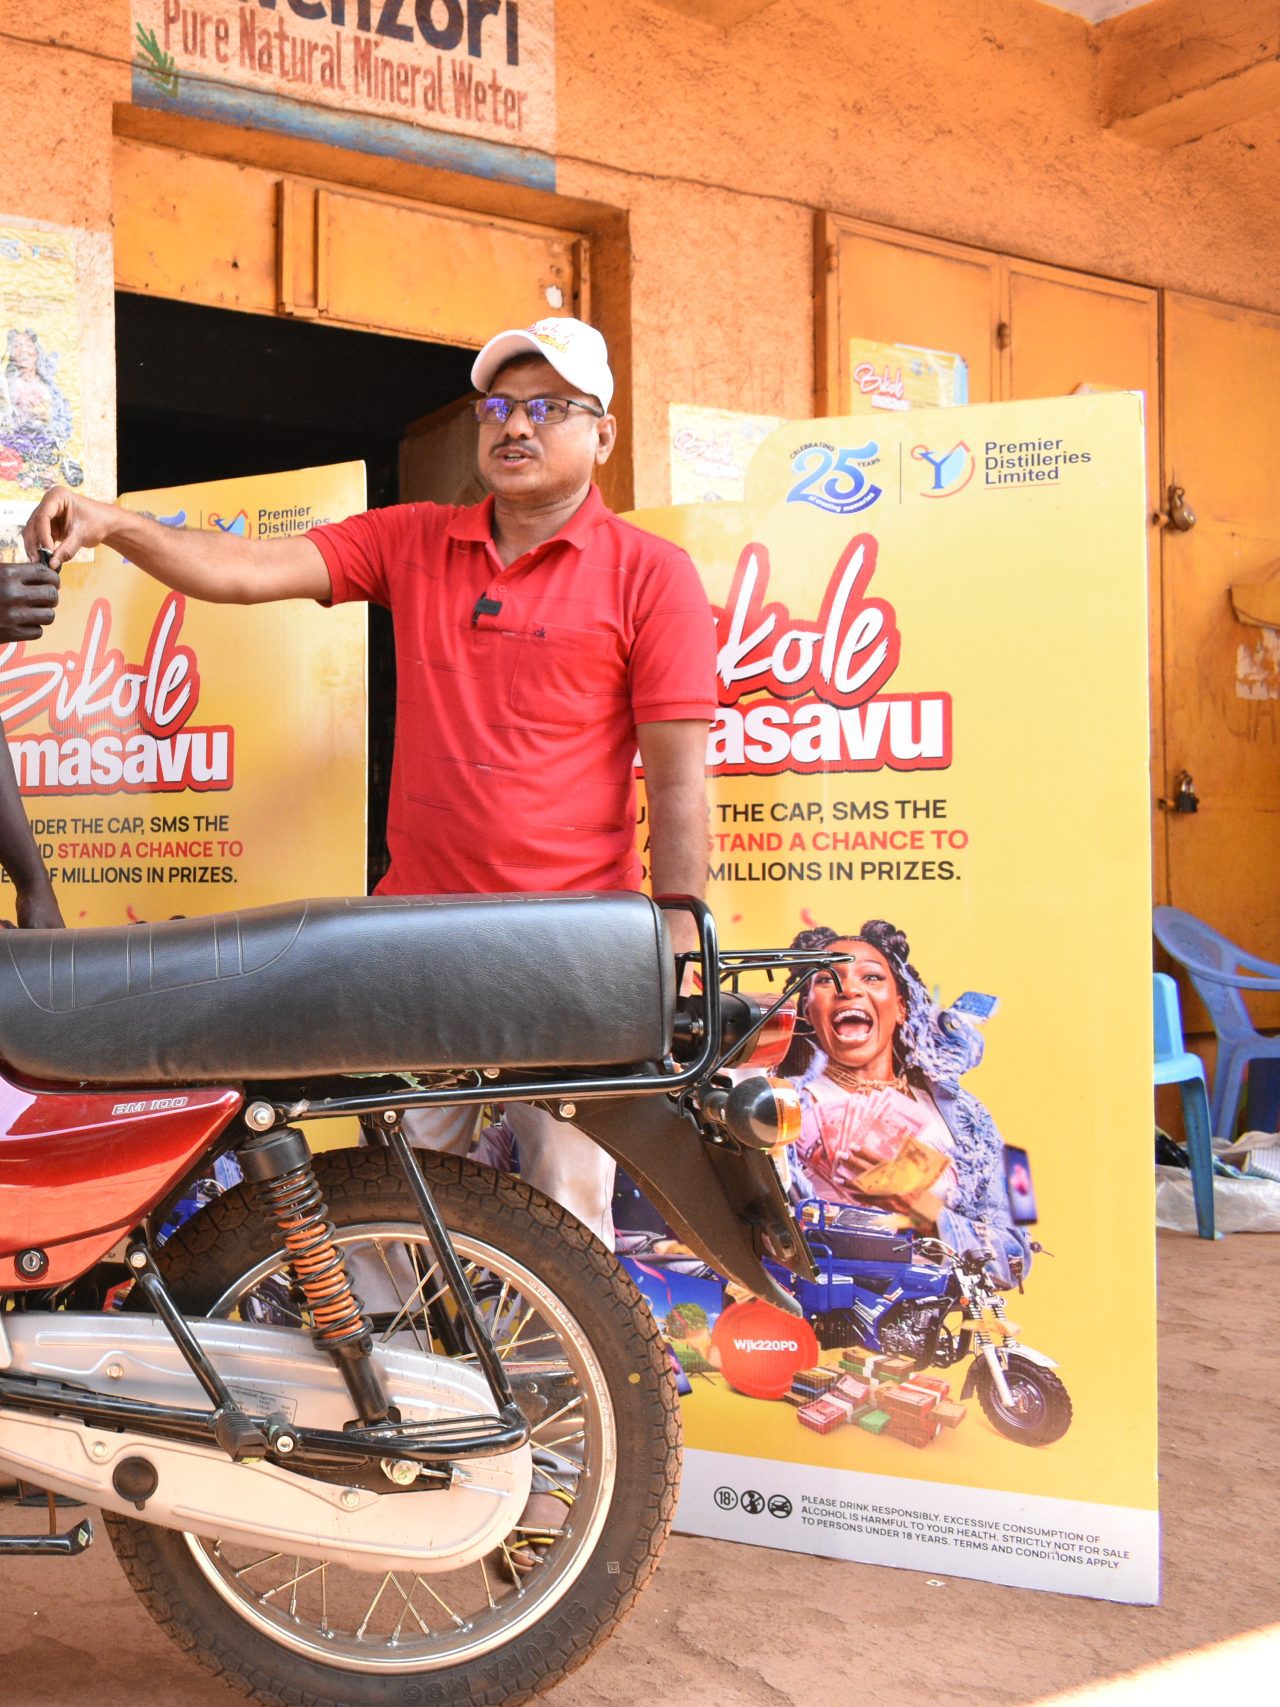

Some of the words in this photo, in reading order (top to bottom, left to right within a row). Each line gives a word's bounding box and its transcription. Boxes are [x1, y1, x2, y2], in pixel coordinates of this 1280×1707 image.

[163, 2, 229, 63] Pure
[239, 8, 345, 92] Natural
[354, 36, 446, 113] Mineral
[789, 441, 836, 460] CELEBRATING
[985, 438, 1063, 455] Premier
[786, 439, 880, 503] 25
[985, 451, 1091, 470] Distilleries
[985, 467, 1059, 485] Limited
[258, 505, 312, 521] Premier
[713, 543, 889, 694] kole
[705, 700, 944, 766] asavu
[8, 731, 228, 787] masavu
[717, 803, 765, 822] THE
[770, 802, 824, 824] CAP,
[832, 800, 889, 820] SMS
[895, 799, 947, 819] THE
[30, 819, 67, 834] DER
[71, 818, 104, 834] THE
[107, 817, 145, 836] CAP,
[150, 816, 190, 832] SMS
[193, 815, 230, 832] THE
[58, 842, 116, 859] STAND
[120, 842, 132, 858] A
[136, 841, 214, 858] CHANCE
[217, 841, 244, 857] TO
[789, 832, 806, 851] A
[812, 830, 925, 851] CHANCE
[930, 829, 969, 849] TO
[62, 867, 143, 883] MILLIONS
[147, 867, 164, 883] IN
[169, 866, 238, 883] PRIZES.
[707, 862, 822, 881] MILLIONS
[829, 862, 853, 880] IN
[861, 860, 961, 880] PRIZES.
[112, 1101, 146, 1115] BM
[150, 1096, 189, 1111] 100
[733, 1339, 798, 1353] Wjk220PD
[801, 1495, 838, 1508] PLEASE
[839, 1500, 869, 1512] DRINK
[871, 1505, 942, 1522] RESPONSIBLY.
[944, 1515, 1000, 1530] EXCESSIVE
[1002, 1523, 1084, 1542] CONSUMPTION
[1086, 1534, 1101, 1544] OF
[801, 1506, 847, 1520] ALCOHOL
[849, 1513, 859, 1521] IS
[861, 1515, 908, 1529] HARMFUL
[911, 1521, 924, 1531] TO
[926, 1524, 954, 1535] YOUR
[1002, 1534, 1052, 1549] STRICTLY
[1054, 1542, 1076, 1553] NOT
[1078, 1545, 1099, 1556] FOR
[1103, 1549, 1130, 1559] SALE
[801, 1516, 815, 1525] TO
[817, 1519, 863, 1533] PERSONS
[865, 1526, 899, 1538] UNDER
[902, 1531, 912, 1540] 18
[953, 1538, 989, 1551] TERMS
[991, 1544, 1013, 1554] AND
[1086, 1557, 1119, 1569] APPLY
